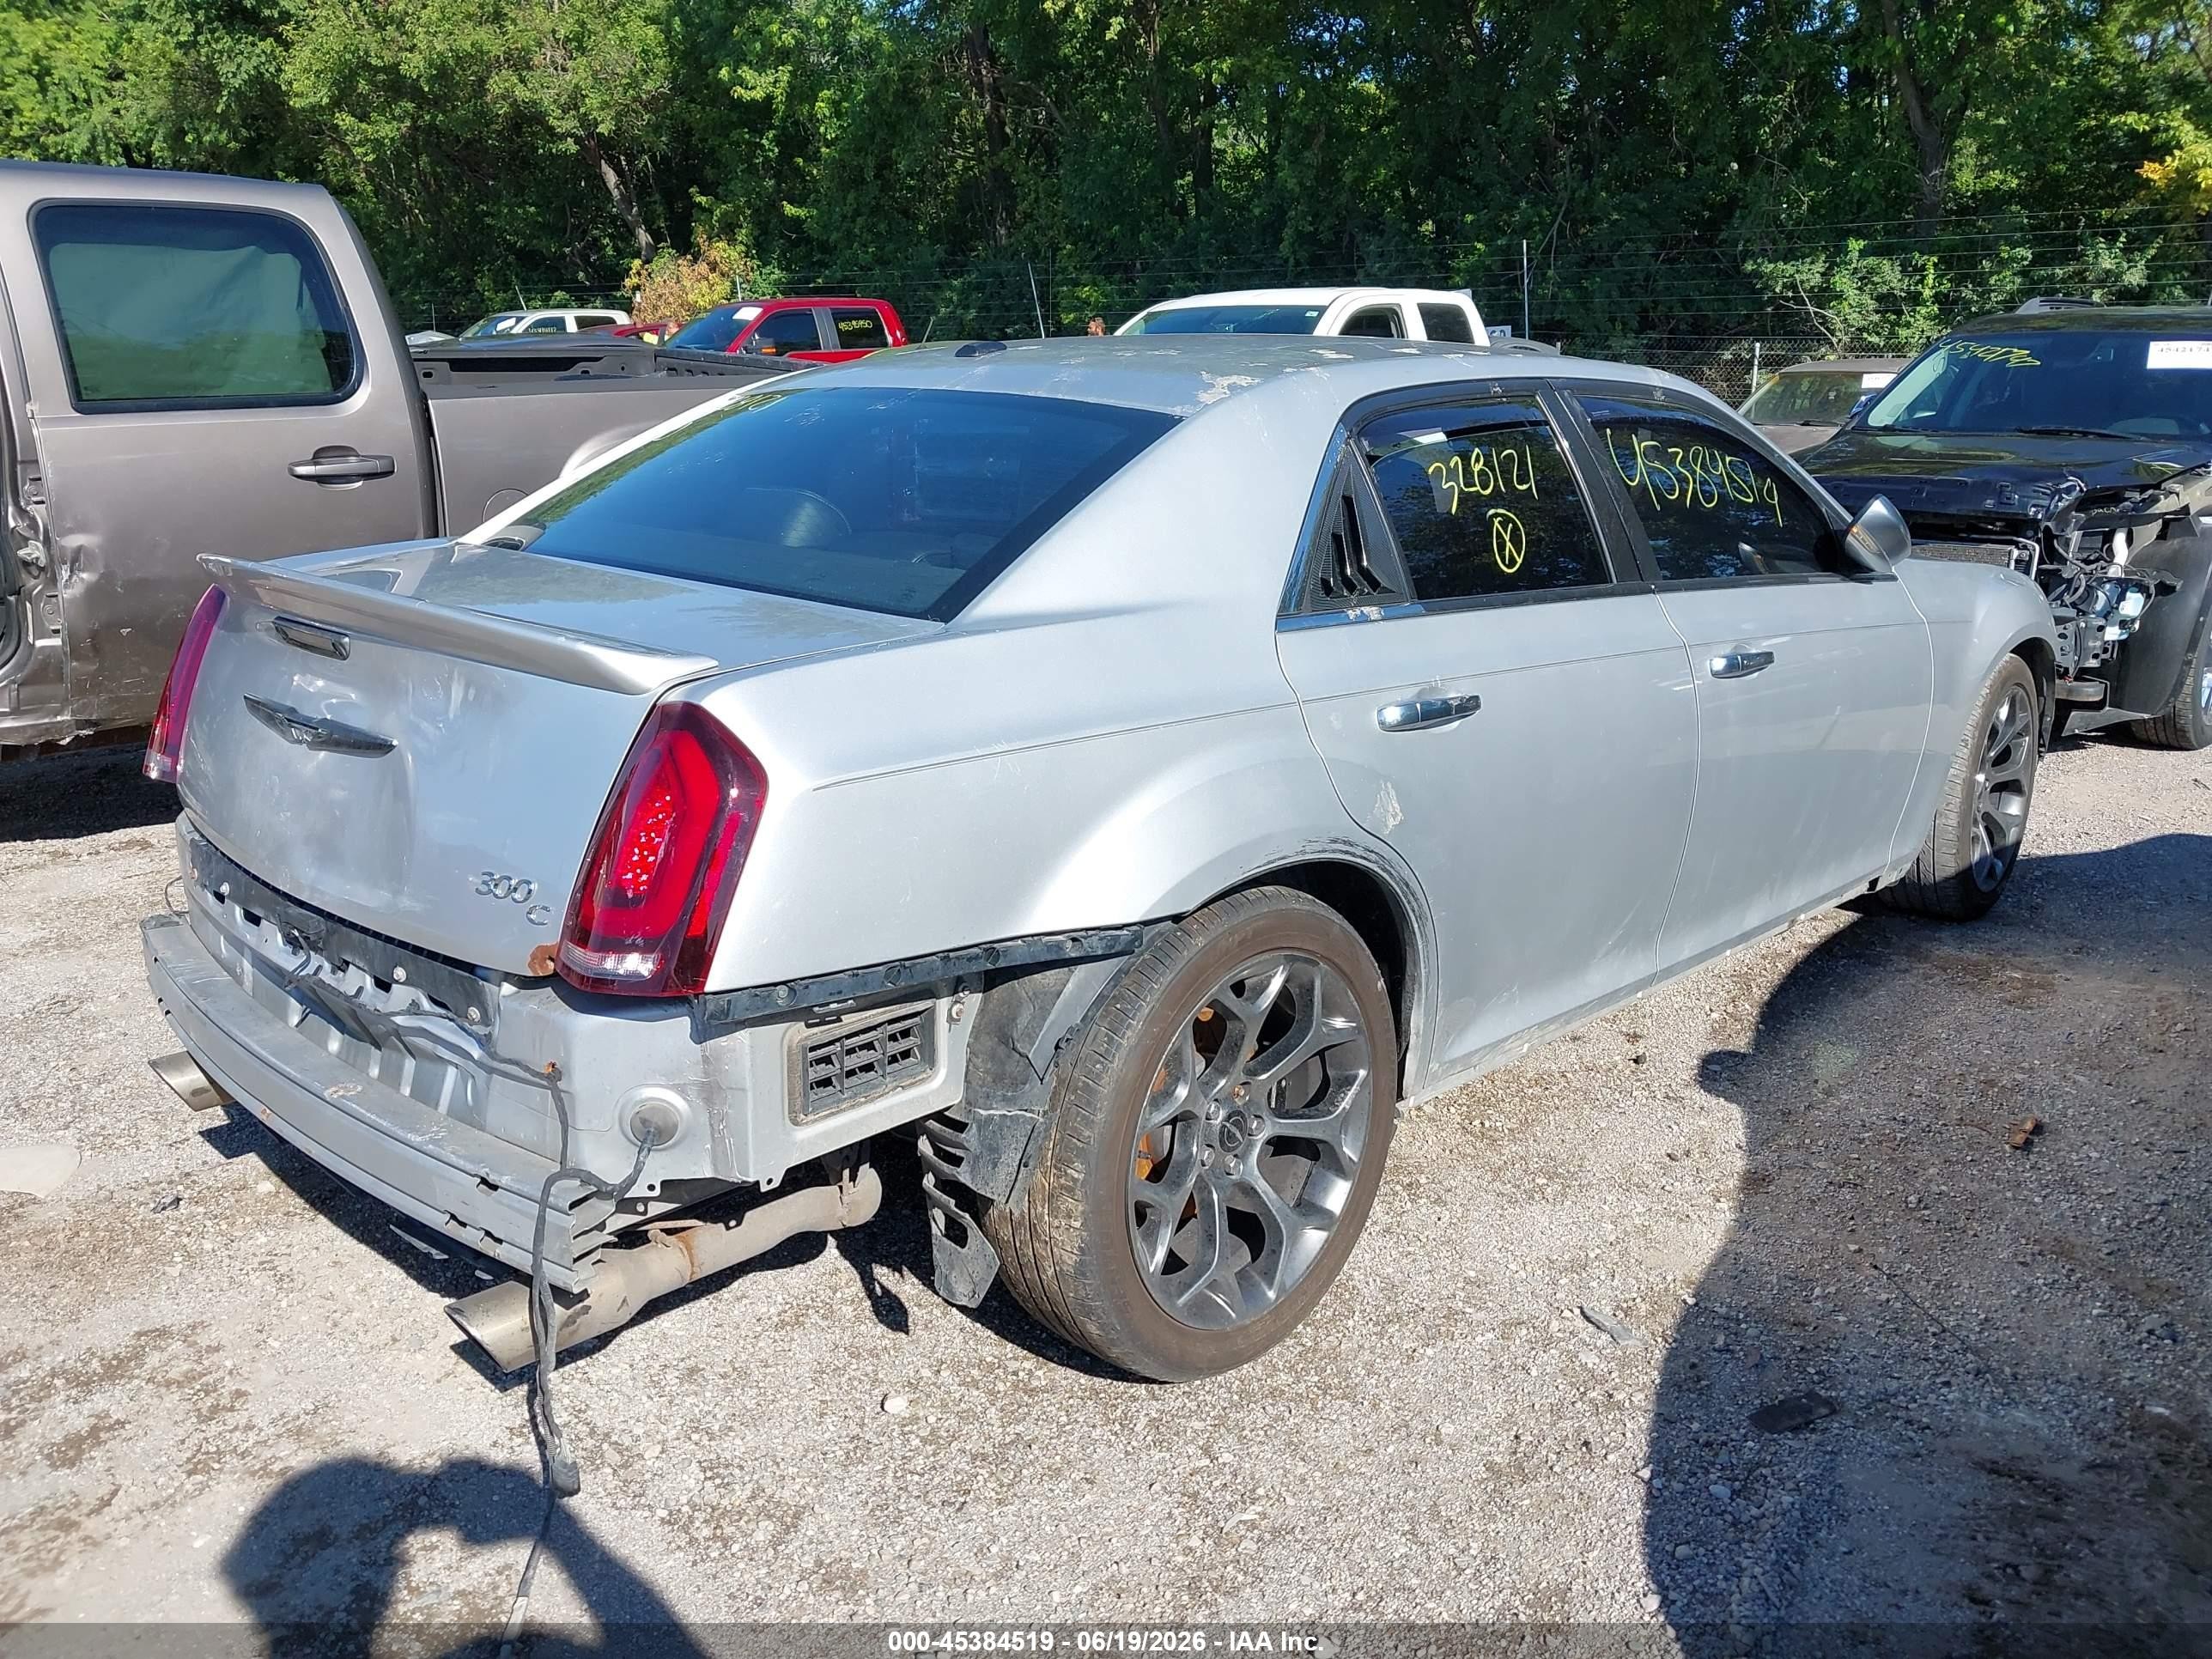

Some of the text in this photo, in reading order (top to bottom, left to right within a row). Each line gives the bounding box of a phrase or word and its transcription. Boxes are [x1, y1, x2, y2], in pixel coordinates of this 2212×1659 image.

[1428, 444, 1539, 515] 328121
[1606, 427, 1784, 528] 45384519
[475, 871, 551, 927] 300 C
